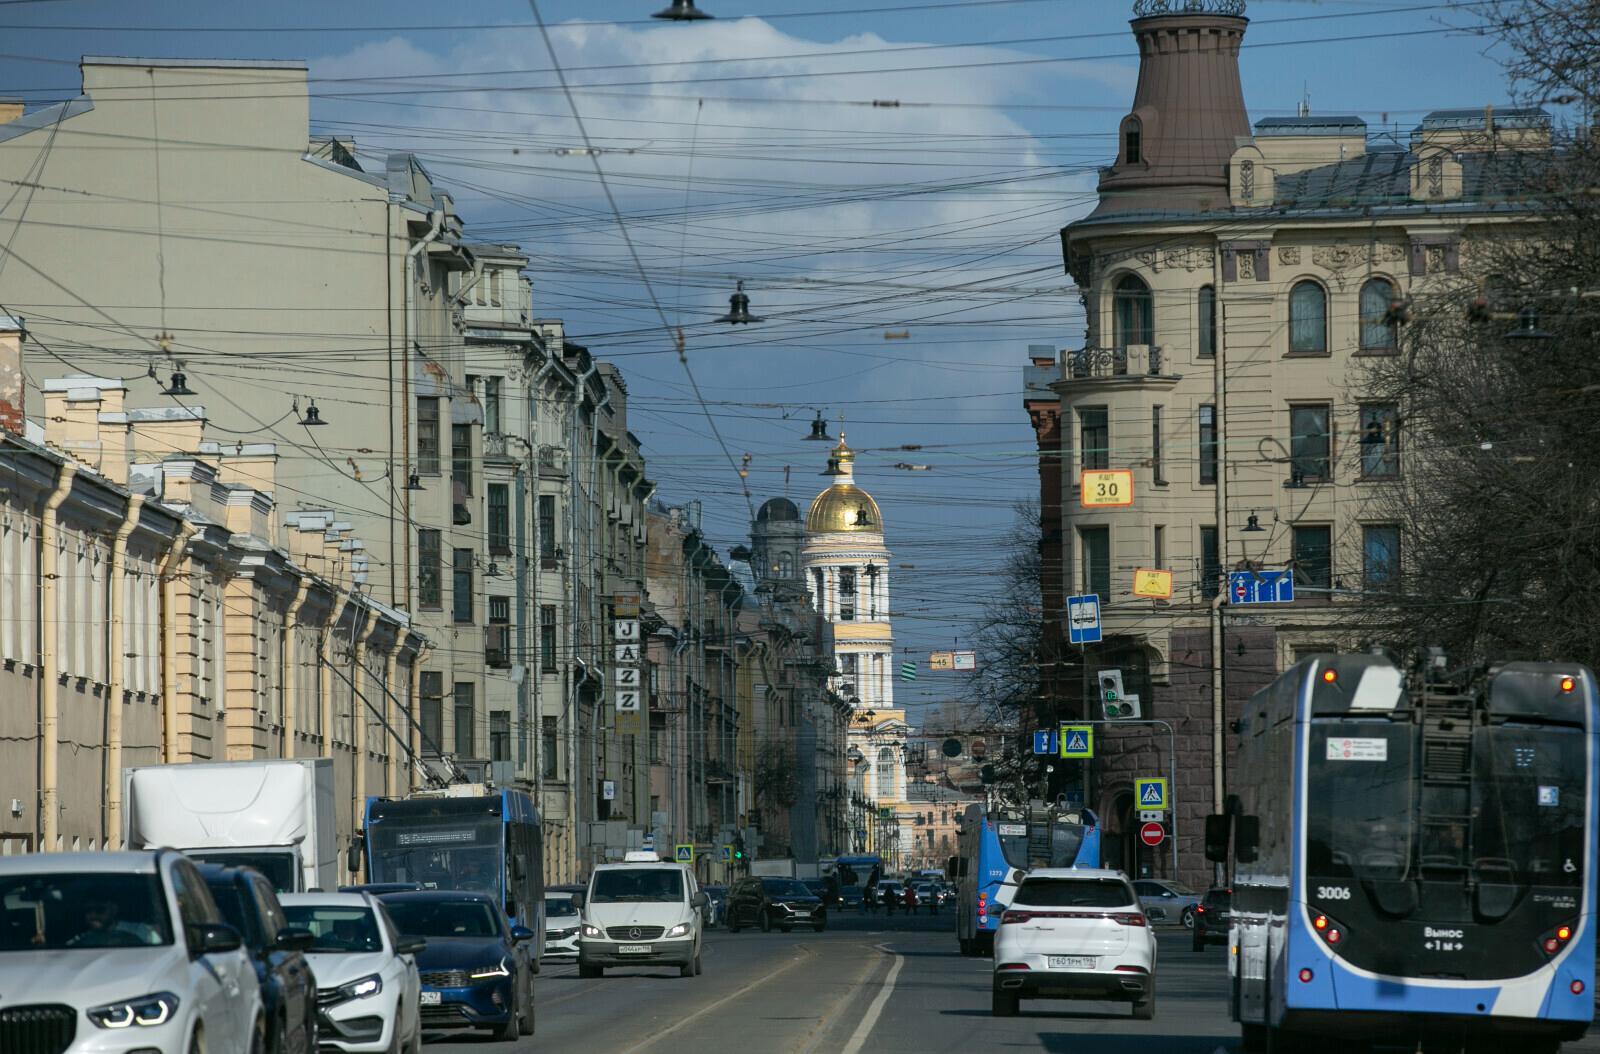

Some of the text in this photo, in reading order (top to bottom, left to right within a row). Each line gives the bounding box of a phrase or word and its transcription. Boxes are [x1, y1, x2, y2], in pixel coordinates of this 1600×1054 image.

[1097, 482, 1118, 496] 30
[620, 623, 635, 708] JAZZ
[1317, 886, 1351, 899] 3006
[1424, 926, 1464, 938] Вынос
[1435, 941, 1441, 950] 1
